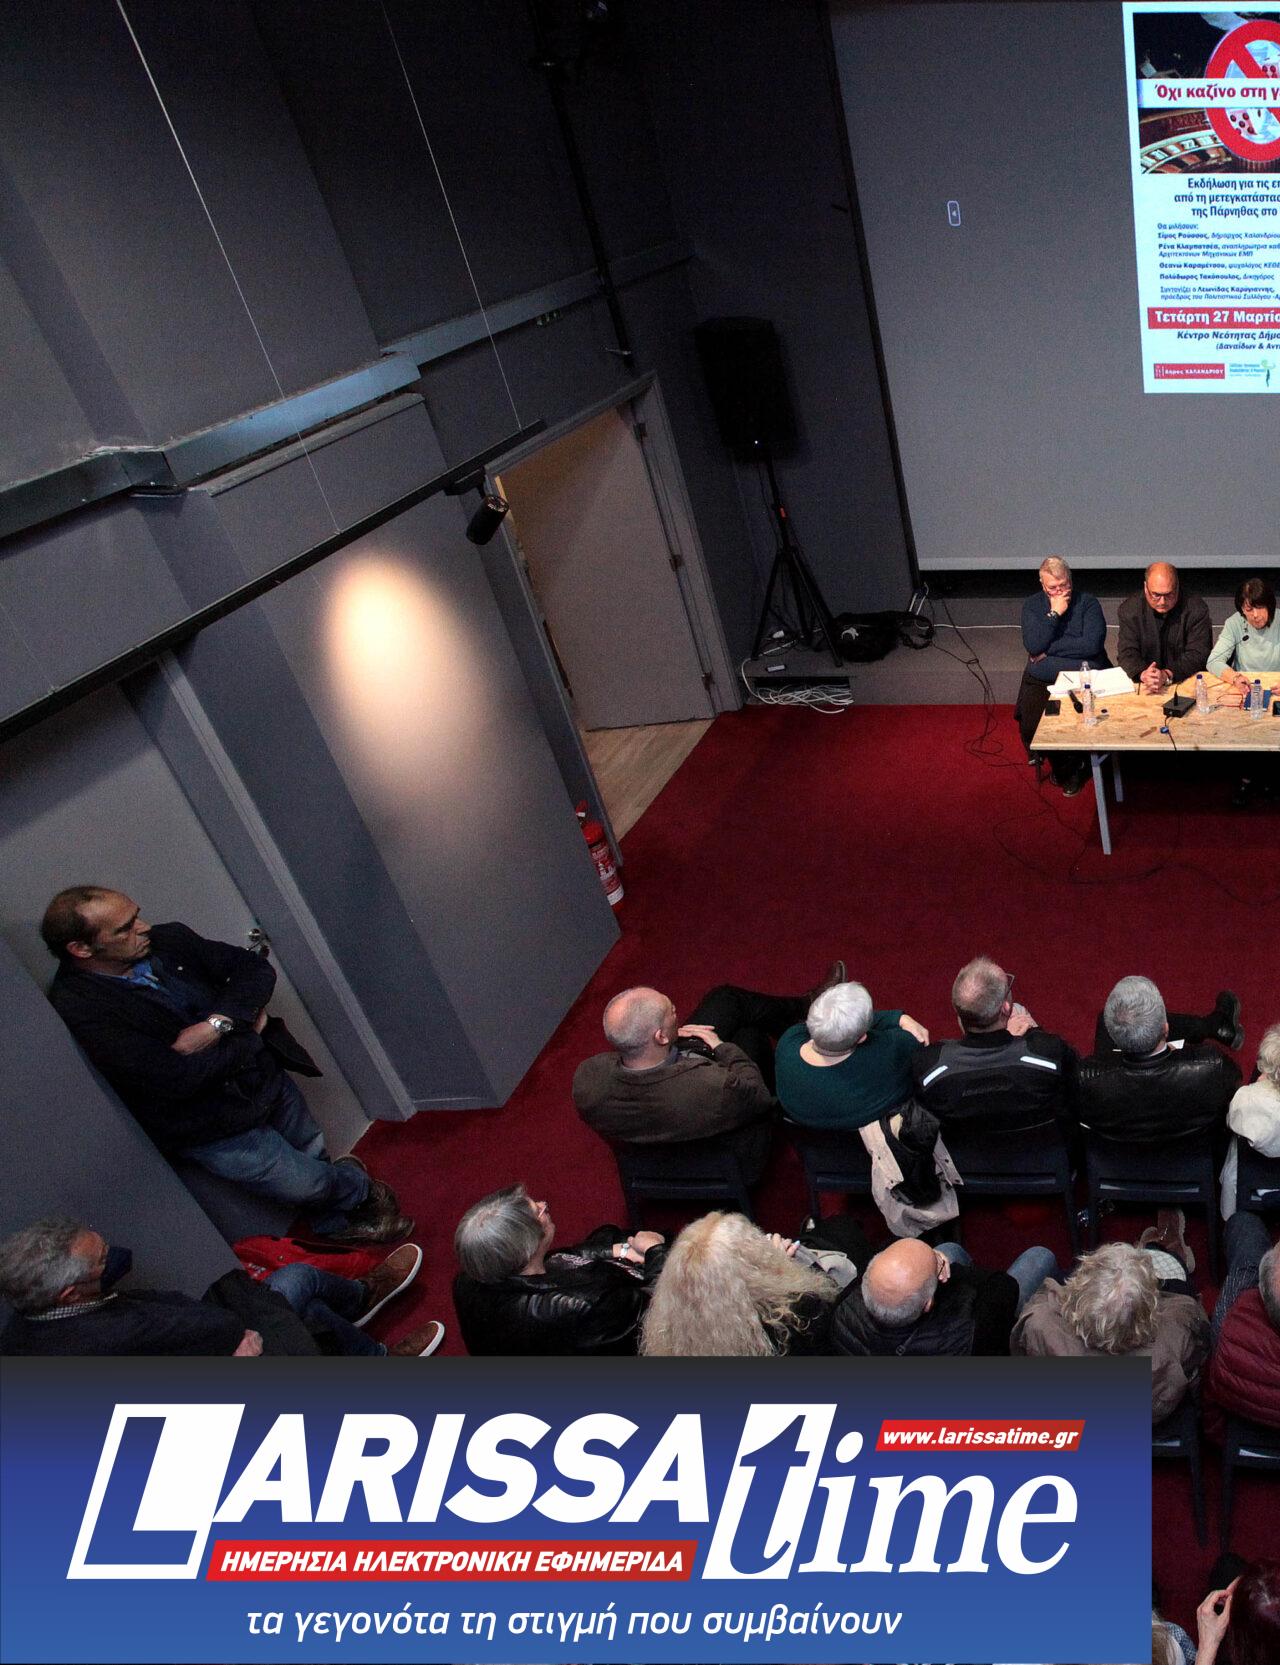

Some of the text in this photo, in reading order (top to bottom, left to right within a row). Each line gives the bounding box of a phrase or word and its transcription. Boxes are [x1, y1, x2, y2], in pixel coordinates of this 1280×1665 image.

[1155, 84, 1181, 101] Όχι
[1187, 84, 1236, 100] καζίνο
[1240, 88, 1267, 100] στη
[1188, 178, 1237, 190] Εκδήλωση
[1238, 180, 1254, 190] για
[1256, 180, 1269, 190] τις
[1174, 192, 1193, 202] από
[1196, 194, 1206, 204] τη
[1191, 208, 1208, 217] της
[1210, 206, 1259, 218] Πάρνηθας
[1261, 208, 1277, 216] στο
[1155, 310, 1209, 325] Τετάρτη
[1213, 311, 1229, 322] 27
[1177, 331, 1209, 341] Κέντρο
[1212, 331, 1256, 341] Νεότητας
